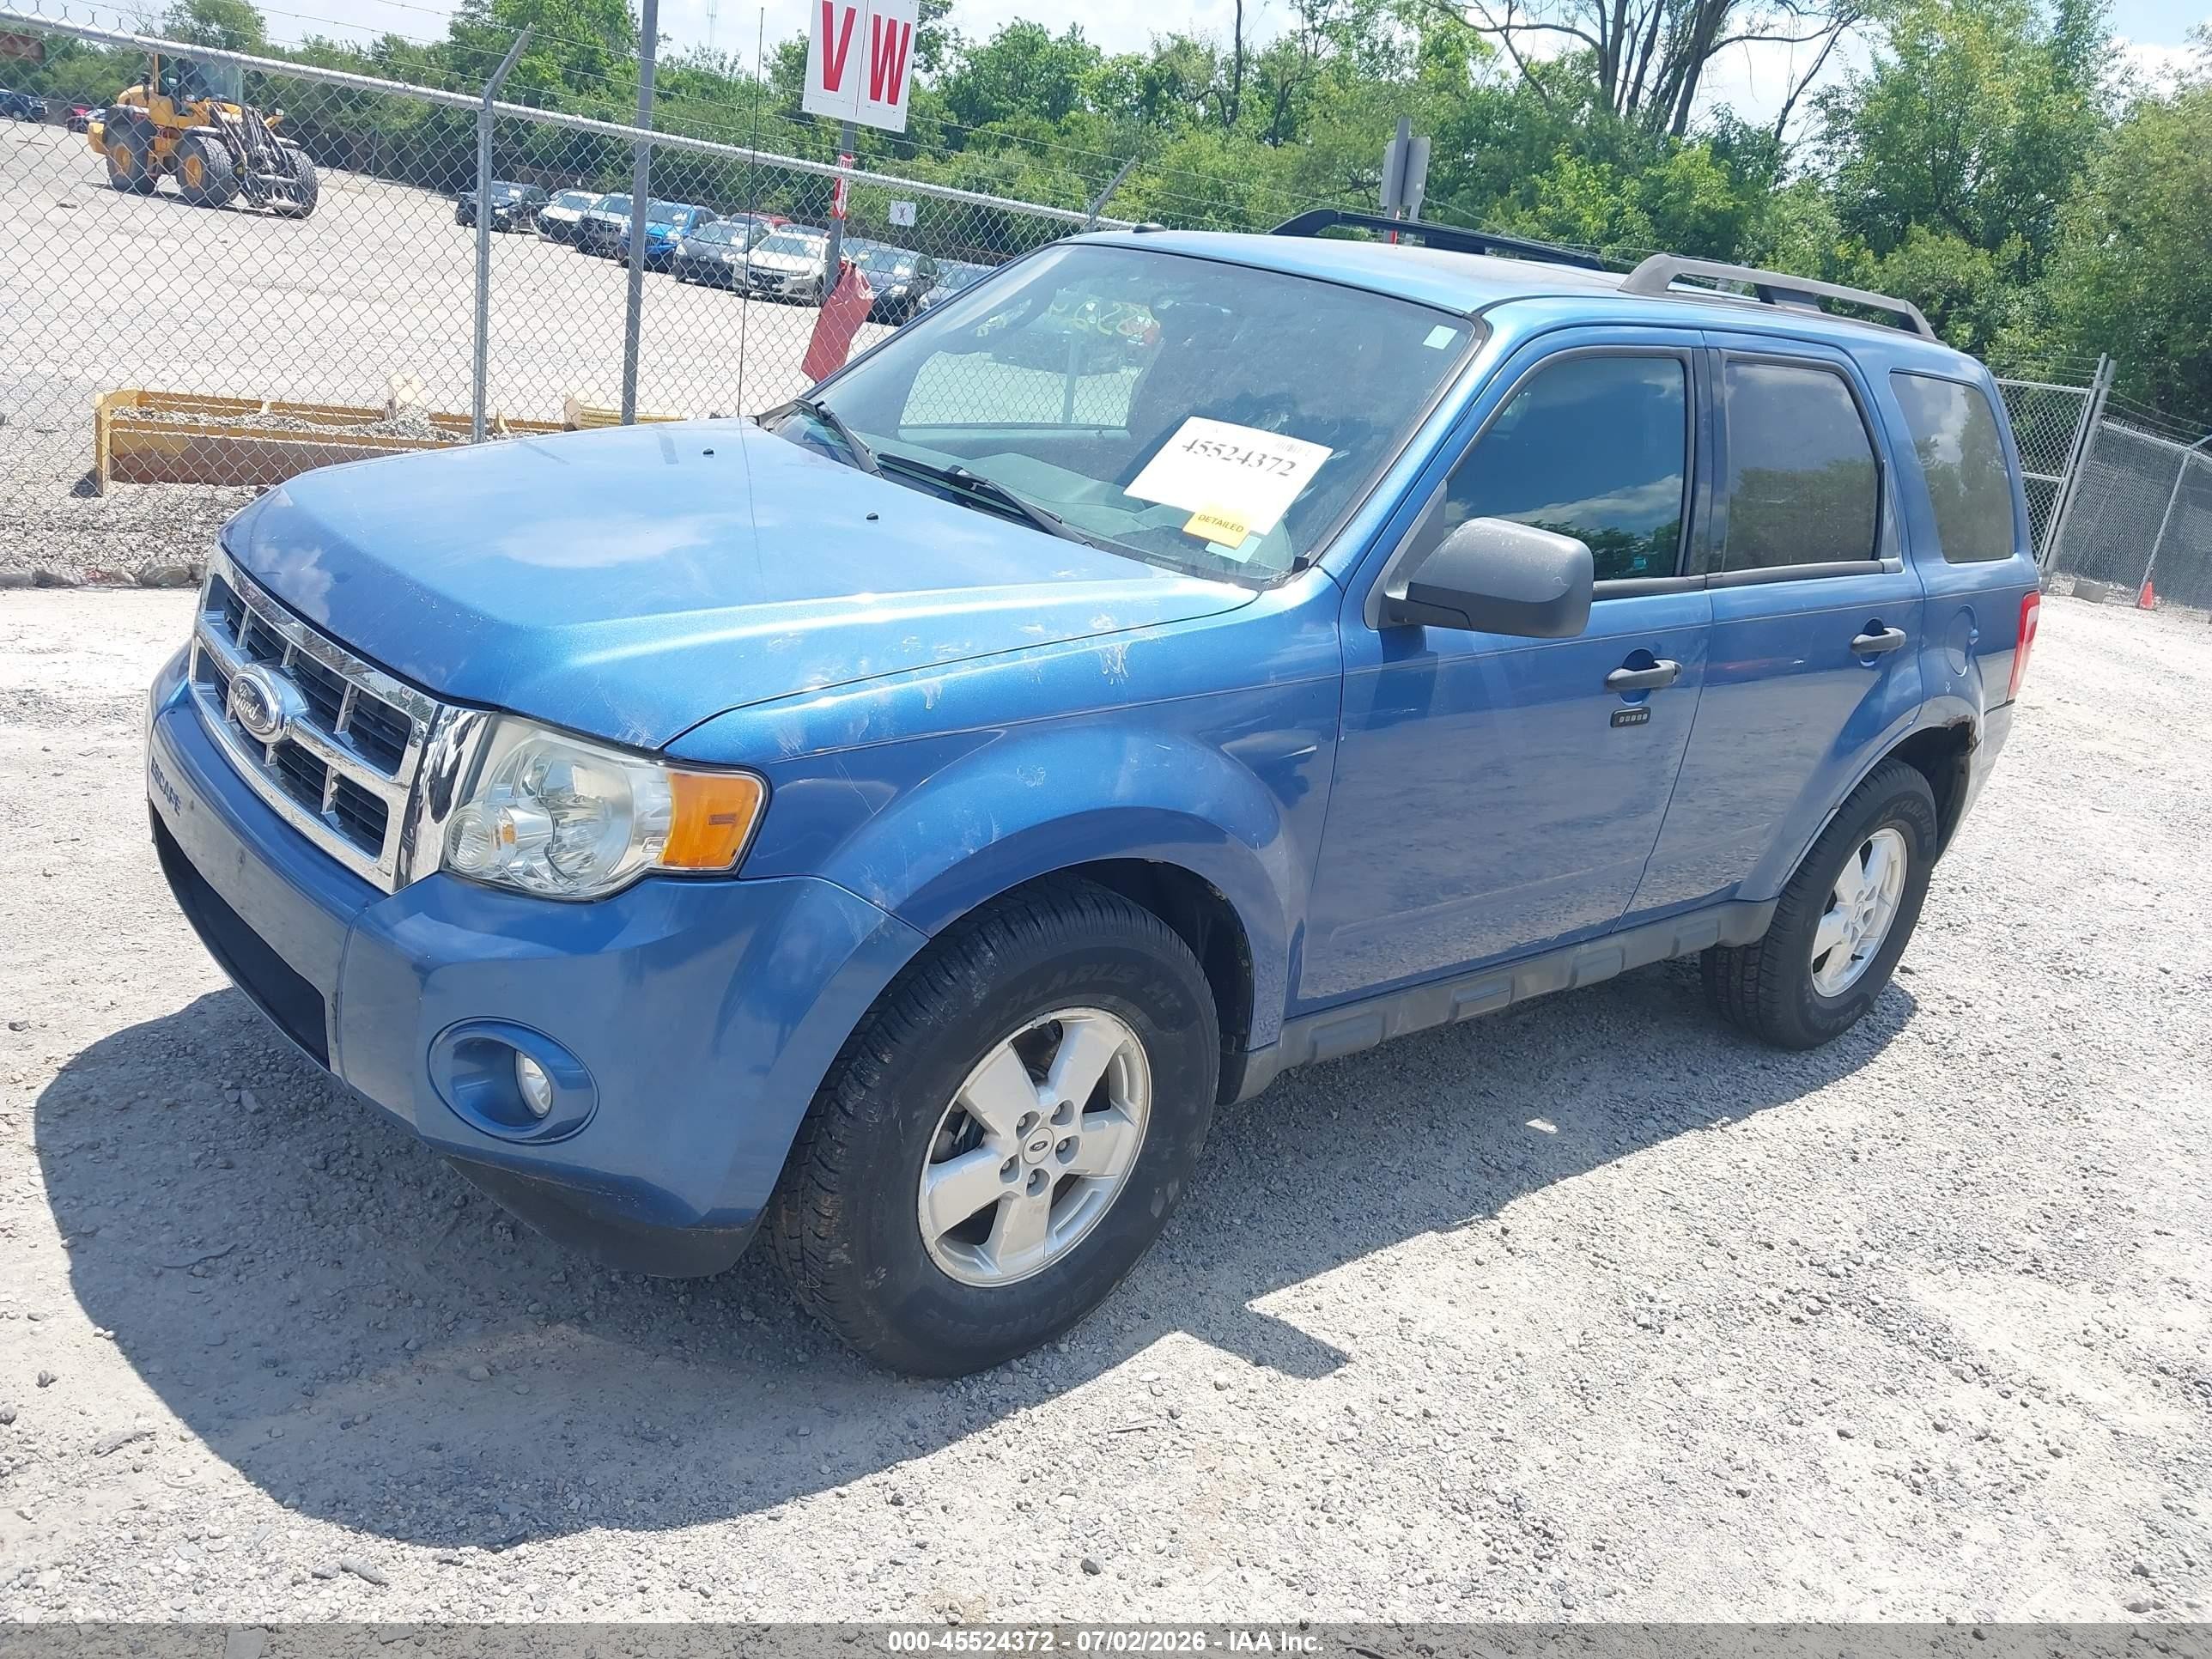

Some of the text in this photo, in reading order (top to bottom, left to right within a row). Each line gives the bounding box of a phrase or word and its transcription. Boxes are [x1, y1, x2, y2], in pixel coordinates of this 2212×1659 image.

[1182, 438, 1297, 477] 45524372
[1197, 514, 1244, 532] DETAILED
[234, 682, 261, 721] Ford
[151, 756, 182, 817] ESCAPE
